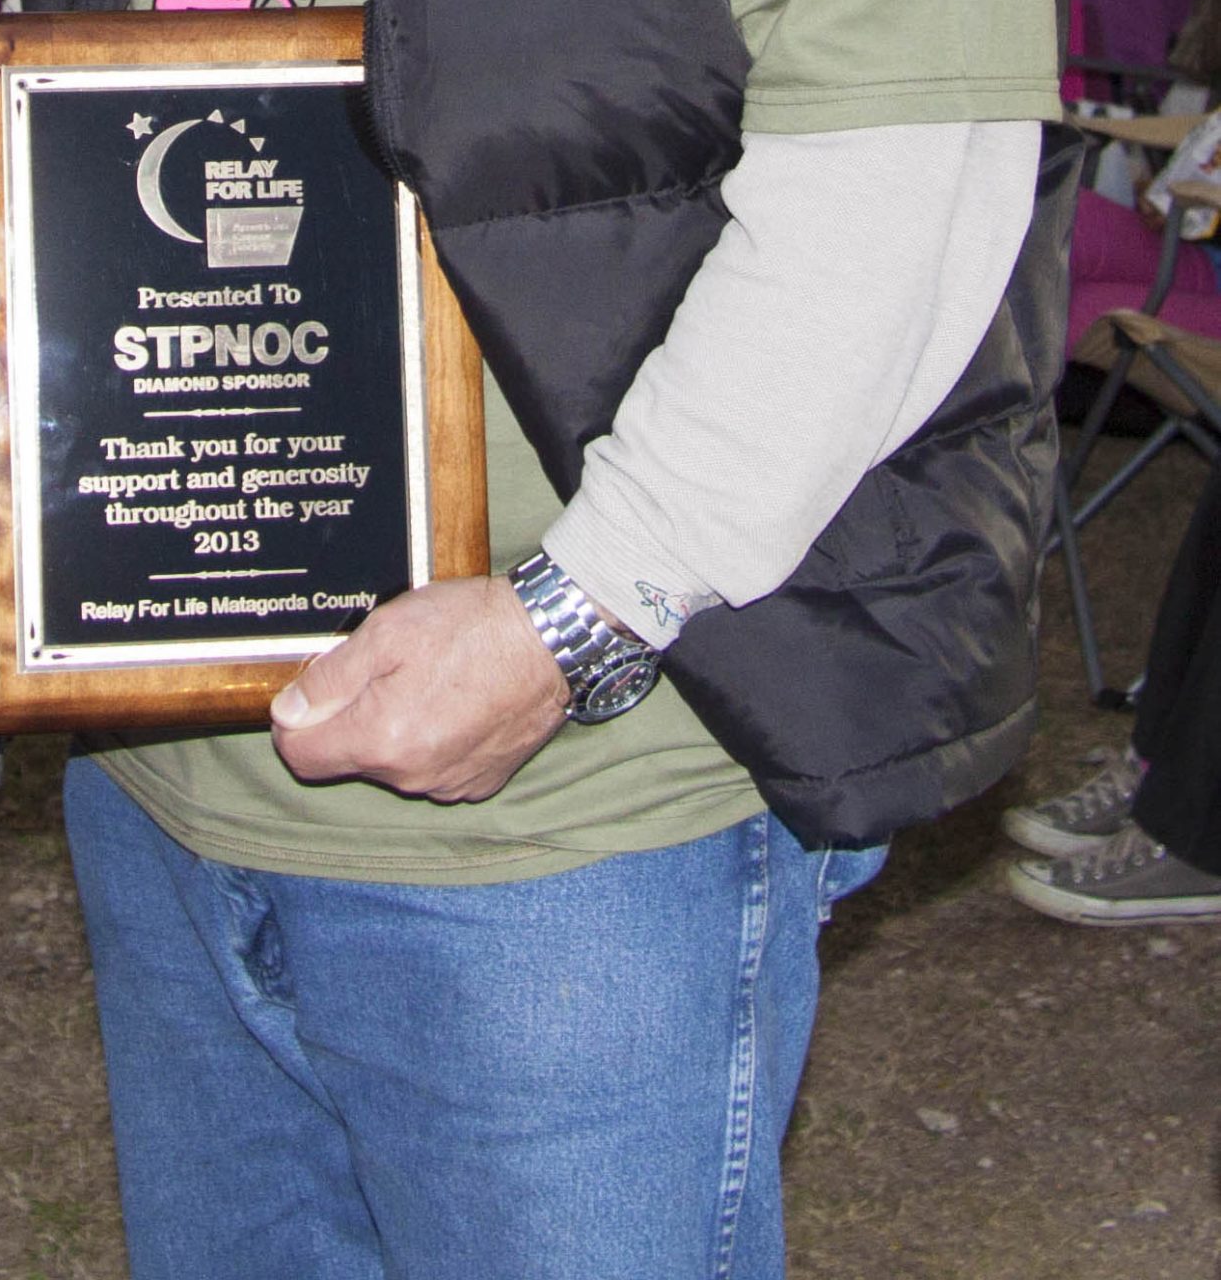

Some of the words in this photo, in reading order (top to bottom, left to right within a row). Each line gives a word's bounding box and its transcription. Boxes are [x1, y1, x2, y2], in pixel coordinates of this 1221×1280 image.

[205, 160, 278, 180] RELAY
[206, 180, 253, 201] FOR
[256, 179, 304, 199] LIFE
[137, 284, 262, 309] Presented
[268, 283, 301, 305] To
[113, 321, 329, 371] STPNOC
[134, 375, 219, 394] DIAMOND
[223, 373, 310, 391] SPONSOR
[100, 436, 185, 460] Thank
[191, 438, 238, 459] you
[244, 433, 281, 455] for
[287, 434, 345, 458] your
[79, 467, 181, 497] support
[187, 466, 235, 489] and
[241, 463, 370, 493] generosity
[105, 499, 247, 528] throughout
[254, 497, 294, 519] the
[299, 499, 353, 521] year
[194, 531, 260, 554] 2013
[81, 600, 134, 621] Relay
[138, 599, 170, 618] For
[174, 597, 208, 616] Life
[212, 594, 308, 619] Matagorda
[313, 590, 378, 612] County
